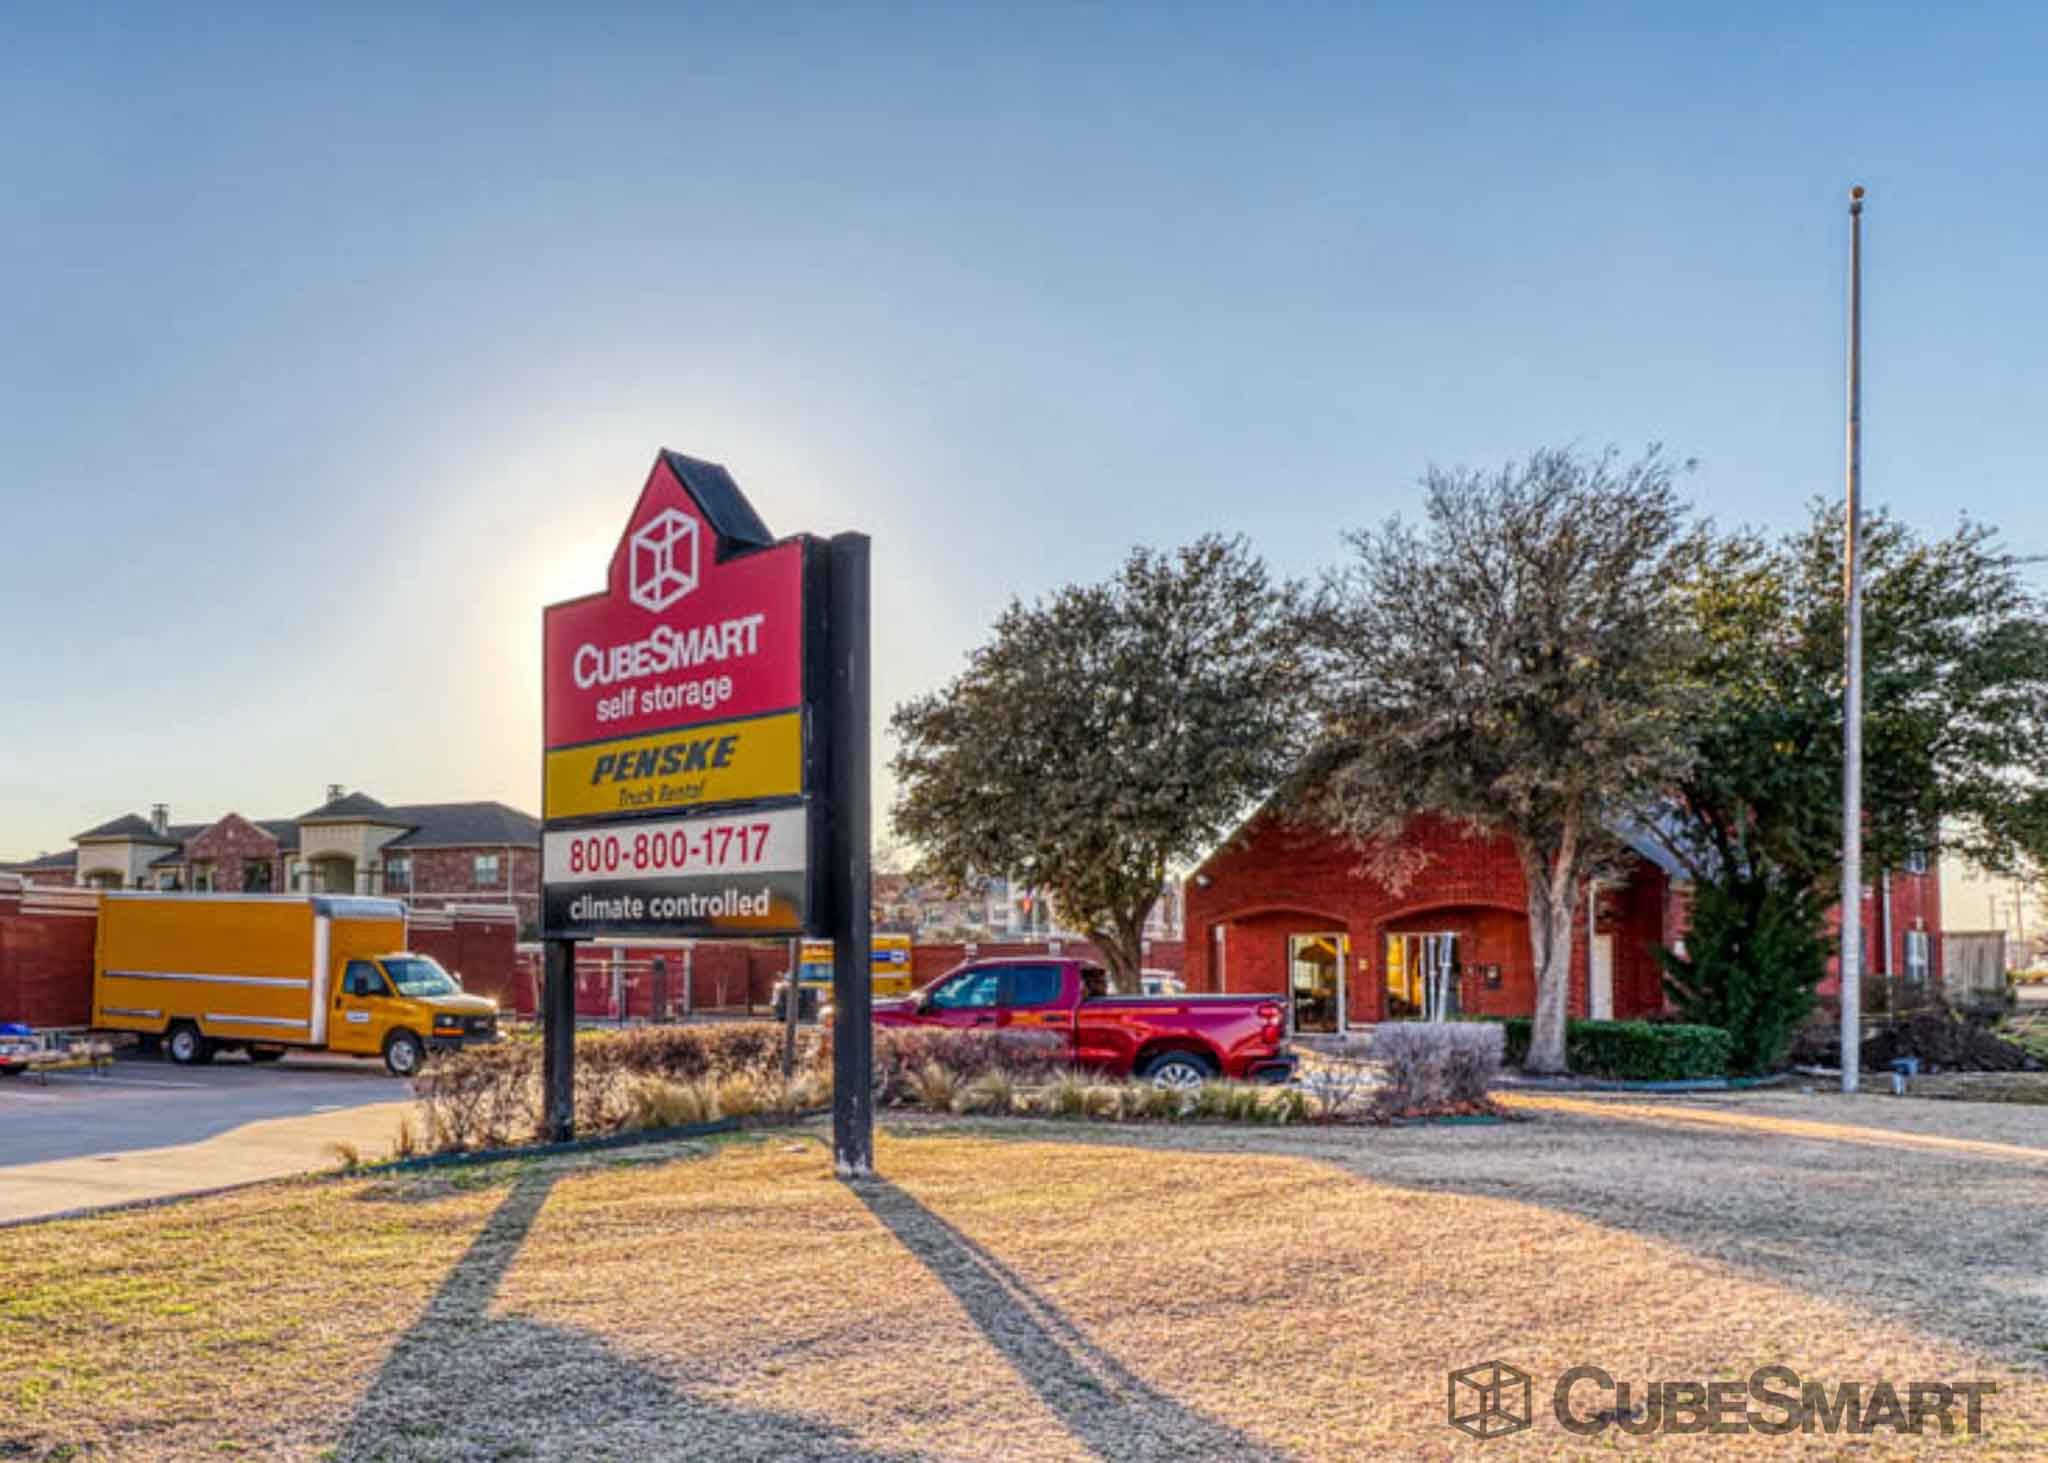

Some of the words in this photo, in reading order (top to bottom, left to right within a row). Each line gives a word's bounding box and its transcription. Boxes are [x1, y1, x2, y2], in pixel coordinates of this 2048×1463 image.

[574, 614, 765, 689] CUBESMART
[597, 686, 637, 721] self
[641, 675, 732, 710] storage
[591, 735, 740, 785] PENSKE
[570, 823, 770, 873] 800-800-1717
[570, 895, 643, 920] climate
[650, 888, 770, 917] controlled
